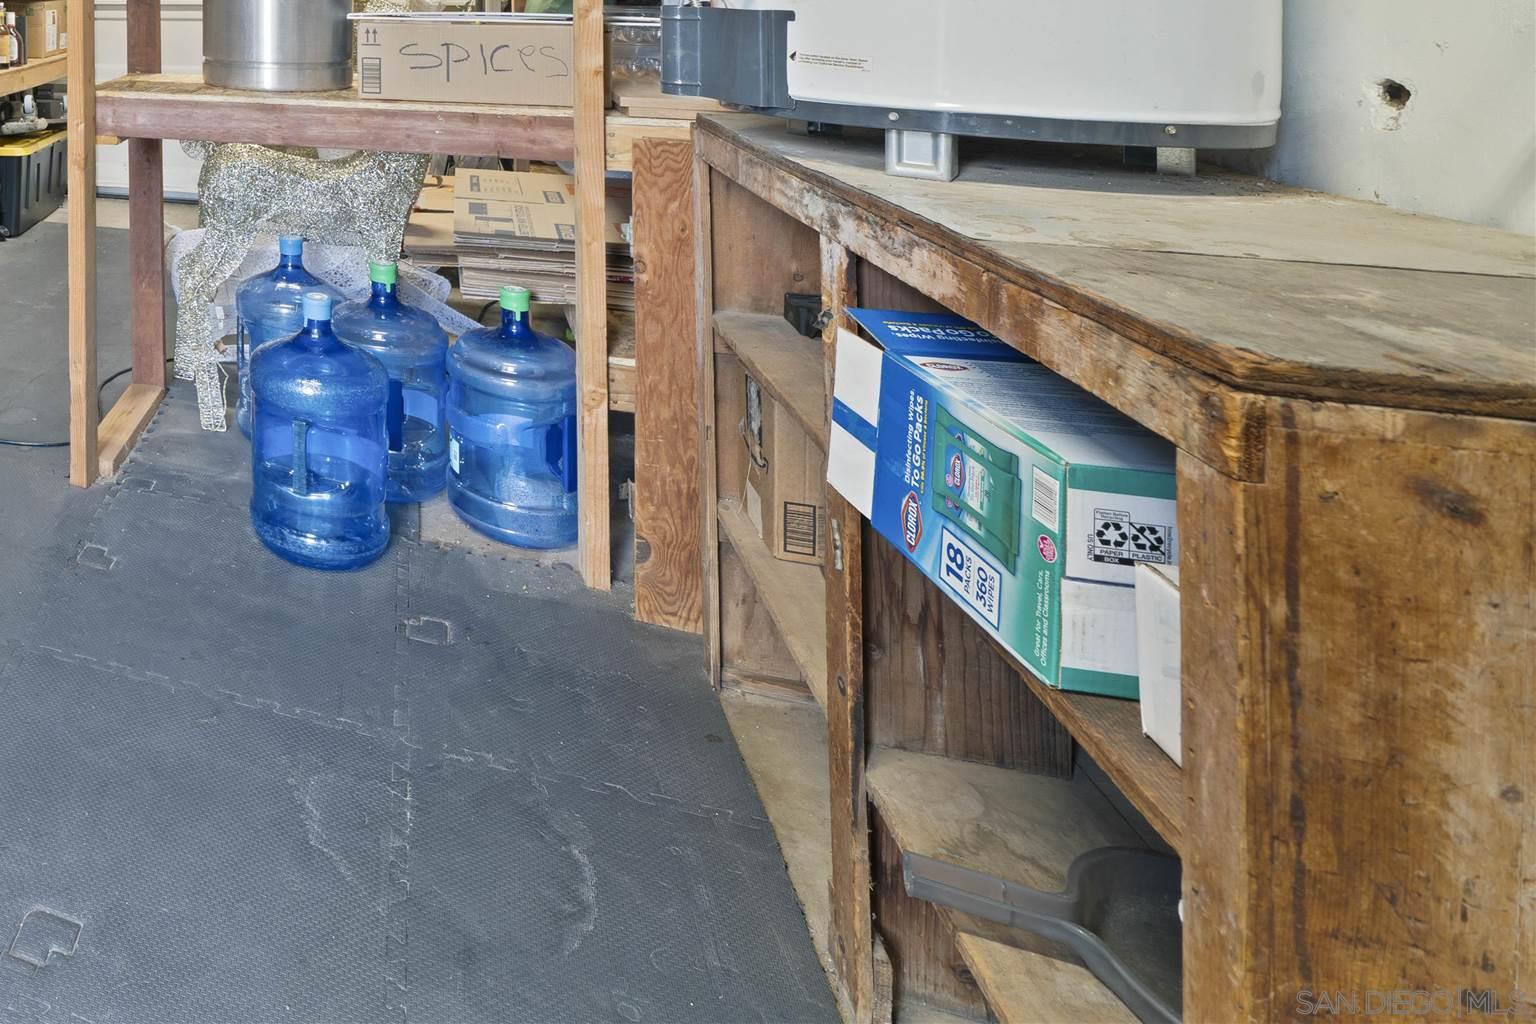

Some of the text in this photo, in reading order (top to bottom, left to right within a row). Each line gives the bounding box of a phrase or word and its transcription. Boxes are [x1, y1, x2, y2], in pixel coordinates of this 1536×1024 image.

[888, 325, 946, 337] Packs
[904, 422, 914, 484] Disinfecting
[911, 395, 924, 488] To Go Packs
[953, 458, 962, 486] CLOROX
[906, 498, 919, 546] CLOROX
[946, 542, 965, 583] 18
[1087, 533, 1095, 561] US ONLY
[1132, 553, 1162, 561] PLASTIC
[964, 556, 972, 594] PACKS
[976, 567, 988, 607] 360
[987, 575, 995, 613] WIPES
[1042, 570, 1050, 617] Classrooms
[1040, 638, 1048, 666] Offices
